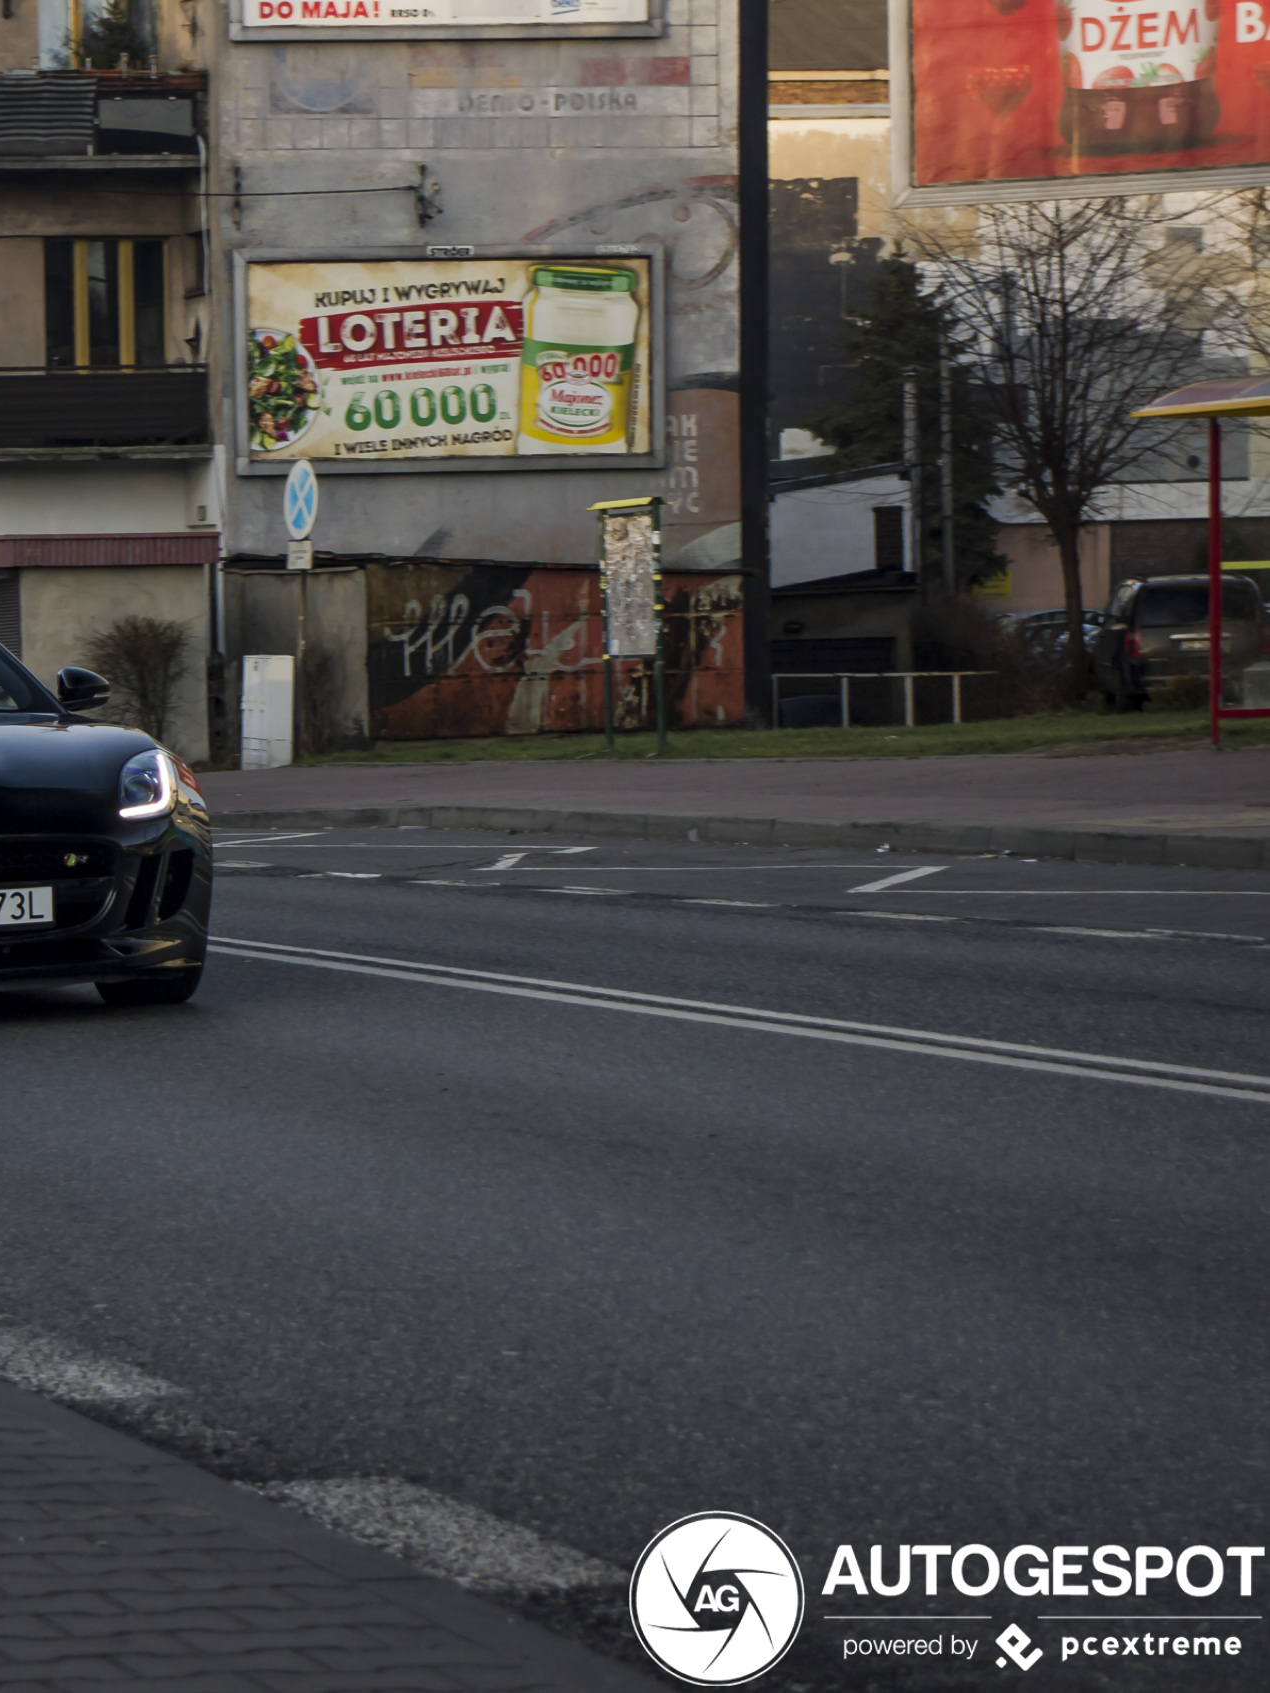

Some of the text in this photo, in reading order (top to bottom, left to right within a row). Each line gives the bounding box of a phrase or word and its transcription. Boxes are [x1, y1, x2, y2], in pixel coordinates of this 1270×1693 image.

[258, 1, 293, 18] DO
[301, 1, 380, 18] MAJA!
[1080, 6, 1200, 52] DŻEM
[1235, 1, 1270, 43] B
[315, 277, 506, 308] KUPUJ I WYGRYWAJ
[317, 305, 517, 353] LOTERIA
[345, 389, 401, 431] 60
[410, 383, 498, 427] 000
[334, 426, 514, 456] I WIELE INNYCH NAGRÓD
